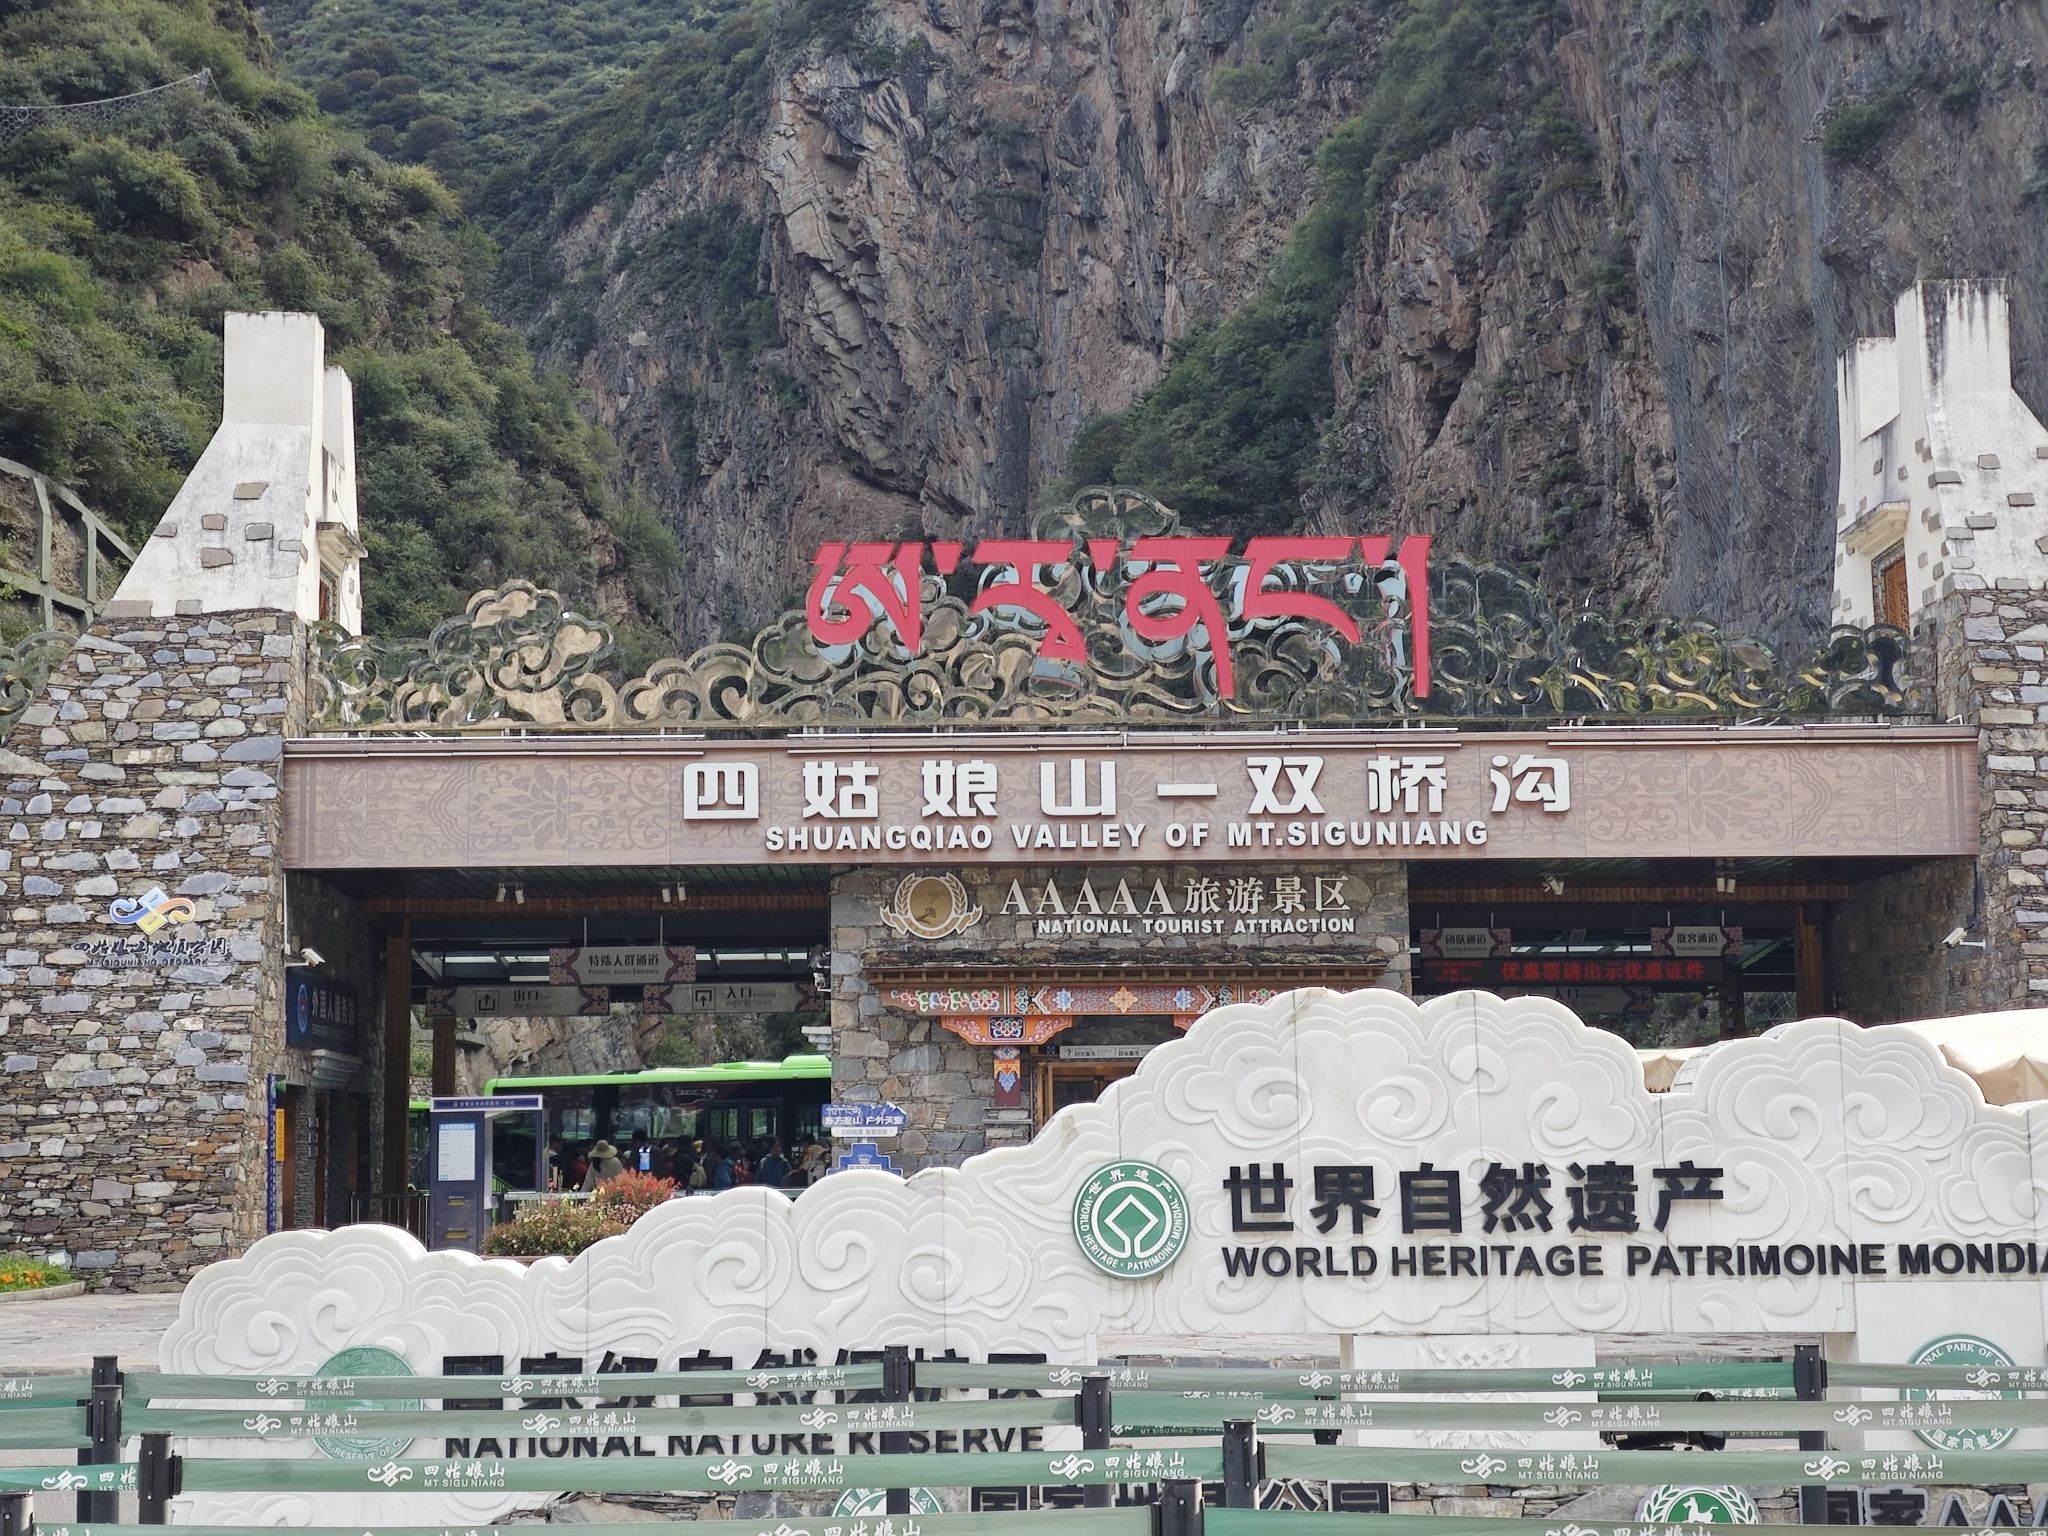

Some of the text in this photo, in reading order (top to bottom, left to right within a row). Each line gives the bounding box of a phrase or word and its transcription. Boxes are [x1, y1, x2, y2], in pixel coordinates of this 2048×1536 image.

[765, 820, 1489, 851] SHUANGQIAO VALLEY OF MT.SIGUNIANG
[1038, 916, 1356, 935] NATIONAL TOURIST ATTRACTION
[163, 958, 209, 966] GEOPARK
[588, 954, 659, 966] 特殊人群通道
[1502, 961, 1705, 981] 优惠票请出示优惠证件
[514, 989, 539, 1001] 出口
[727, 986, 752, 999] 入口
[1222, 1160, 1724, 1234] 世界自然遗产
[1080, 1198, 1183, 1270] WORLD HERITAGE PATRIMOINE MONDIAL
[1222, 1246, 1378, 1277] WORLD
[1392, 1245, 1604, 1277] HERITAGE
[1627, 1243, 1887, 1276] PATRIMOINE
[1946, 1343, 1975, 1353] PARK
[1979, 1347, 1994, 1358] OF
[541, 1376, 600, 1388] 四姑娘山
[785, 1368, 845, 1383] 四姑娘山
[1340, 1372, 1400, 1385] 四姑娘山
[1593, 1369, 1653, 1383] 四姑娘山
[296, 1377, 355, 1390] 四姑娘山
[569, 1411, 636, 1426] 四姑娘山
[847, 1406, 914, 1420] 四姑娘山
[1304, 1404, 1373, 1418] 四姑娘山
[1591, 1403, 1660, 1419] 四姑娘山
[1881, 1403, 1952, 1419] 四姑娘山
[290, 1414, 357, 1427] 四姑娘山
[445, 1427, 1044, 1459] NATIONAL NATURE RSERVE
[379, 1446, 392, 1457] OF
[763, 1458, 843, 1476] 四姑娘山
[1105, 1451, 1184, 1469] 四姑娘山
[1517, 1453, 1599, 1470] 四姑娘山
[1861, 1454, 1943, 1471] 四姑娘山
[99, 1466, 137, 1484] 四姑
[424, 1461, 505, 1479] 四姑娘山
